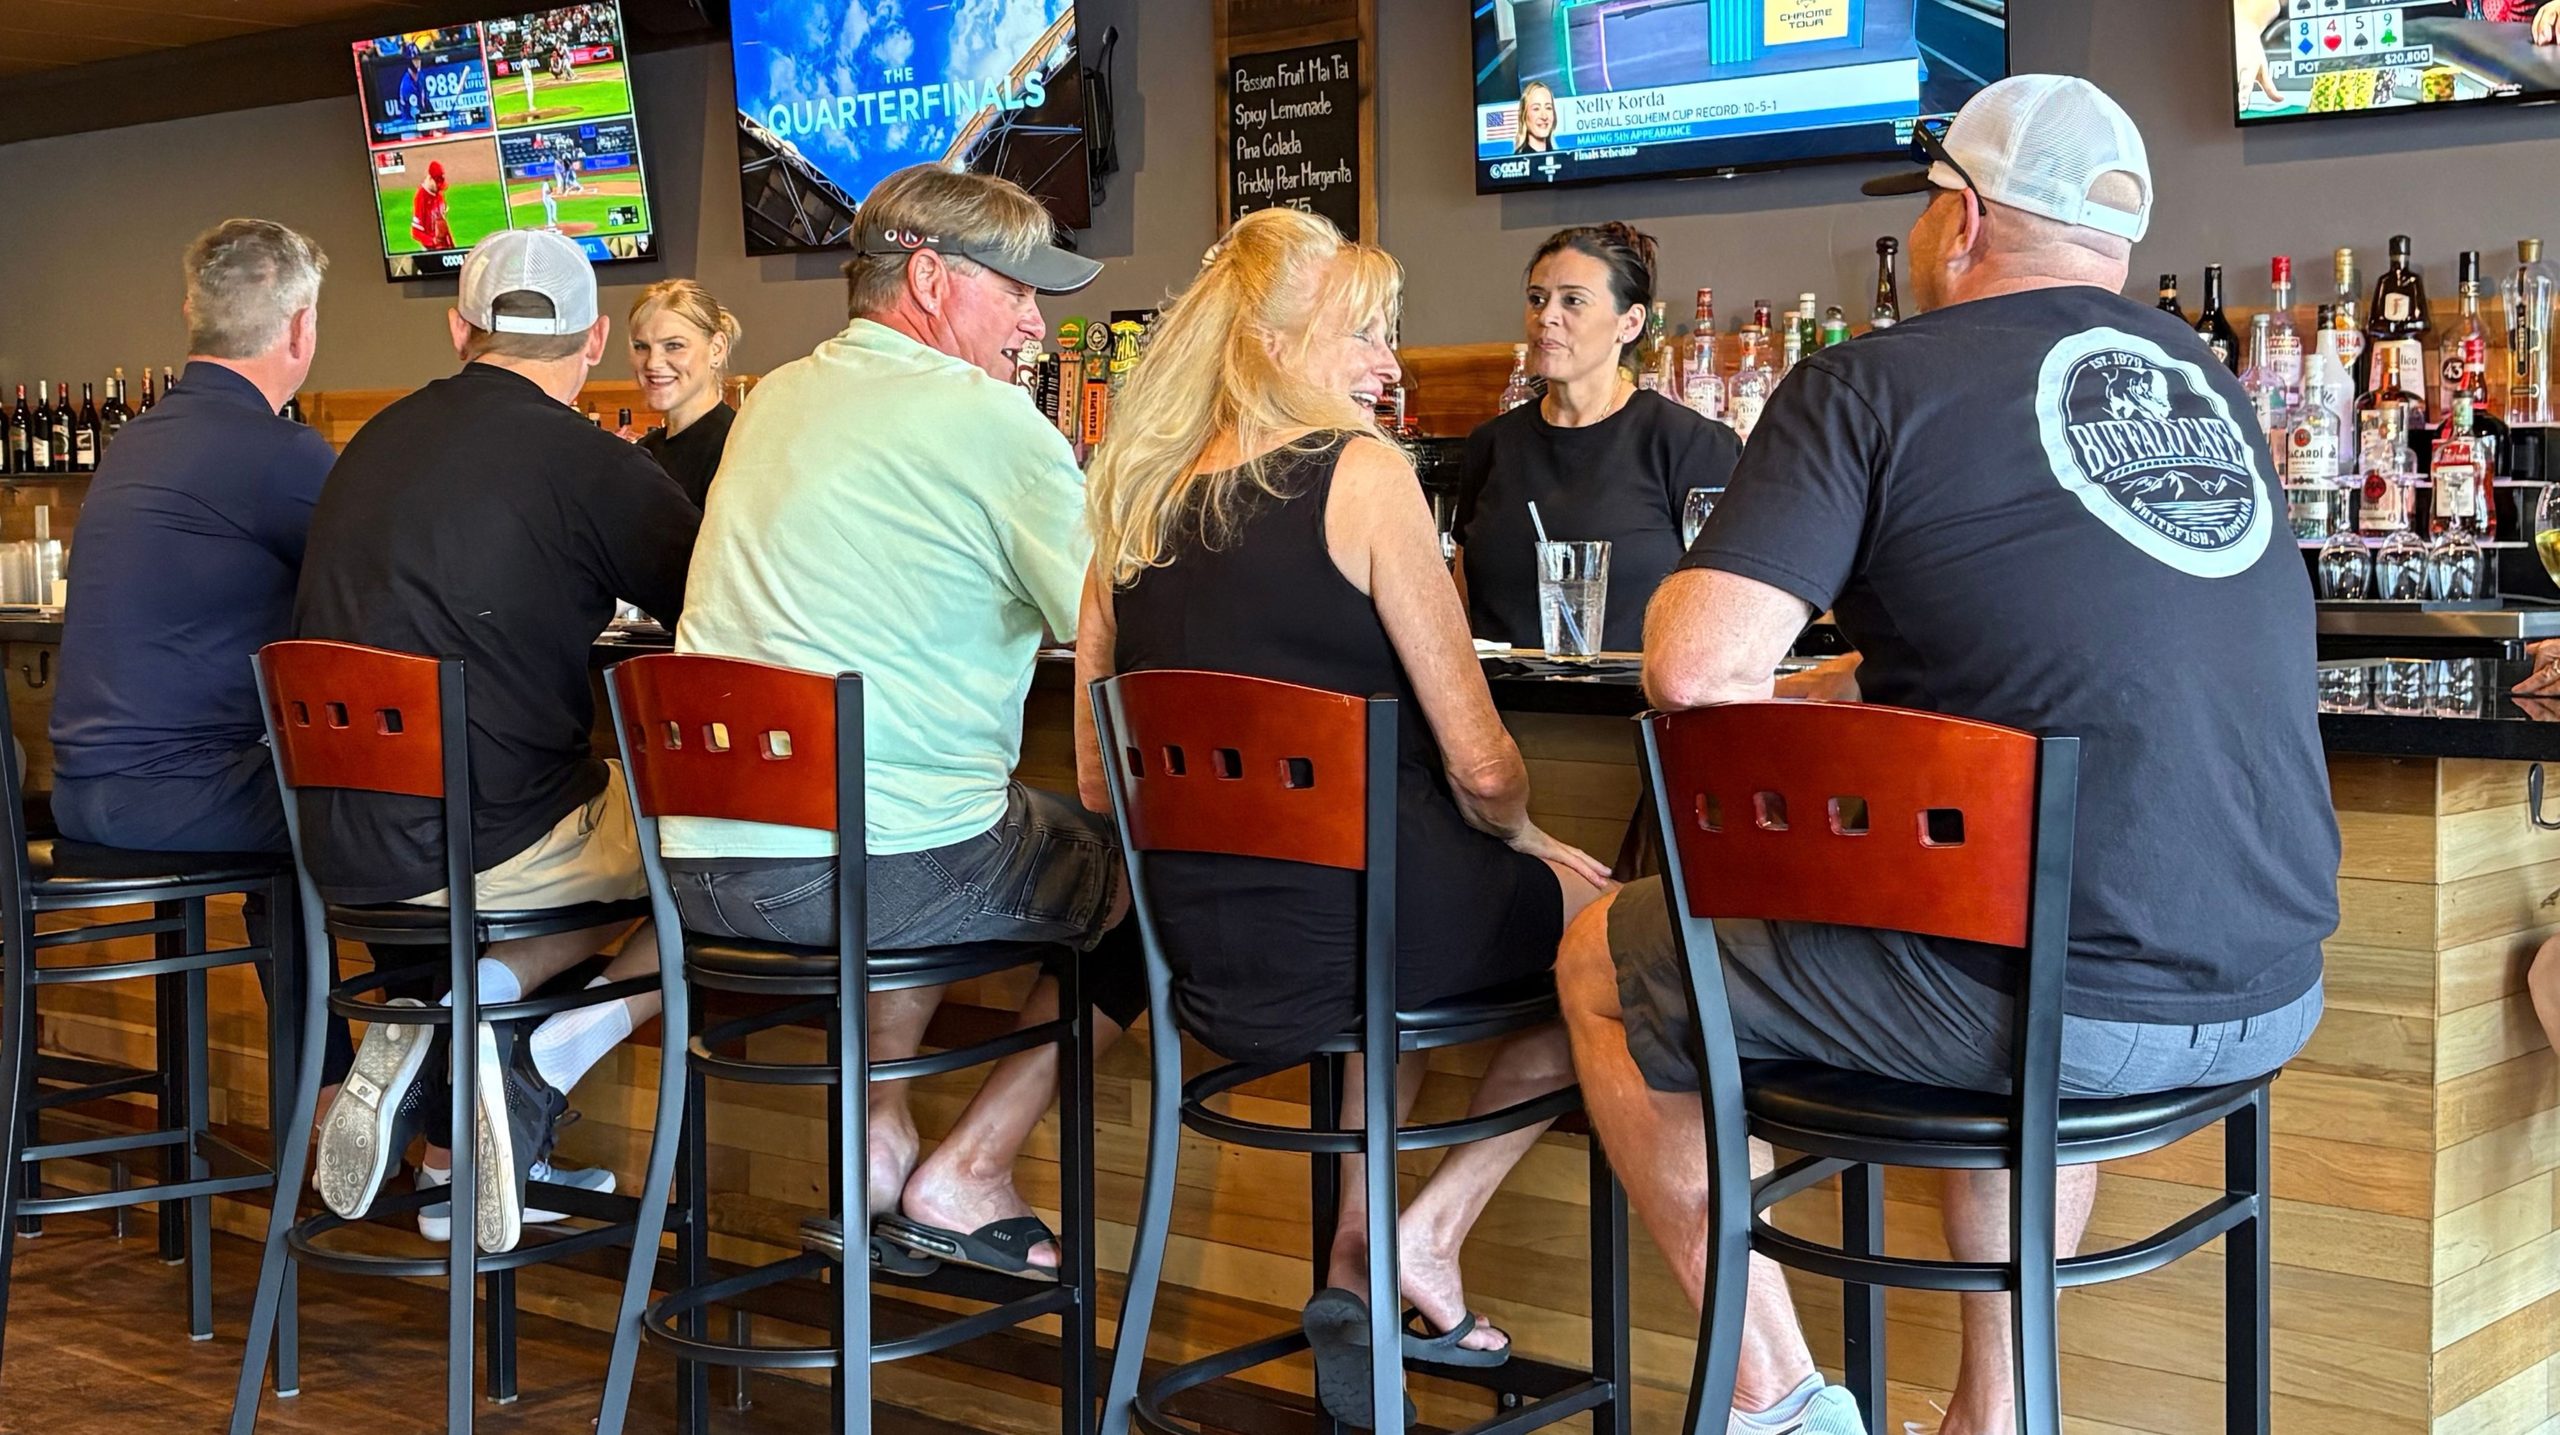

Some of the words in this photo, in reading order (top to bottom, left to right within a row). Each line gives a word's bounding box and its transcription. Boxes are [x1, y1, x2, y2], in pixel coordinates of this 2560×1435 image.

[1780, 8, 1832, 21] CHROME
[1789, 19, 1823, 29] TOUR
[2300, 22, 2309, 35] 8
[2326, 19, 2336, 32] 4
[2355, 15, 2365, 29] 5
[2383, 13, 2392, 26] 9
[883, 67, 914, 83] THE
[1235, 68, 1276, 93] Passion
[1278, 61, 1304, 87] Fruit
[1308, 57, 1330, 83] Mai
[1331, 54, 1349, 79] Tai
[2298, 62, 2320, 73] POT
[425, 72, 459, 97] 988
[767, 71, 1046, 136] QUARTERFINALS
[1235, 104, 1267, 130] Spicy
[1271, 91, 1332, 121] Lemonade
[1576, 97, 1614, 115] Nelly
[1619, 91, 1665, 110] Korda
[1576, 115, 1622, 131] OVERALL
[1625, 111, 1670, 126] SOLHEIM
[1672, 108, 1693, 121] CUP
[1696, 104, 1741, 118] RECORD:
[1744, 100, 1777, 114] 10-5-1
[1263, 130, 1302, 157] Colada
[1577, 132, 1612, 146] MAKING
[1631, 125, 1691, 141] APPEARANCE
[1238, 167, 1274, 199] Prickly
[1276, 165, 1300, 190] Pear
[1301, 158, 1351, 192] Margarita
[2088, 355, 2112, 369] EST.
[2444, 361, 2464, 380] 43
[2068, 418, 2186, 478] BUFFALO
[2177, 417, 2245, 467] CAFE
